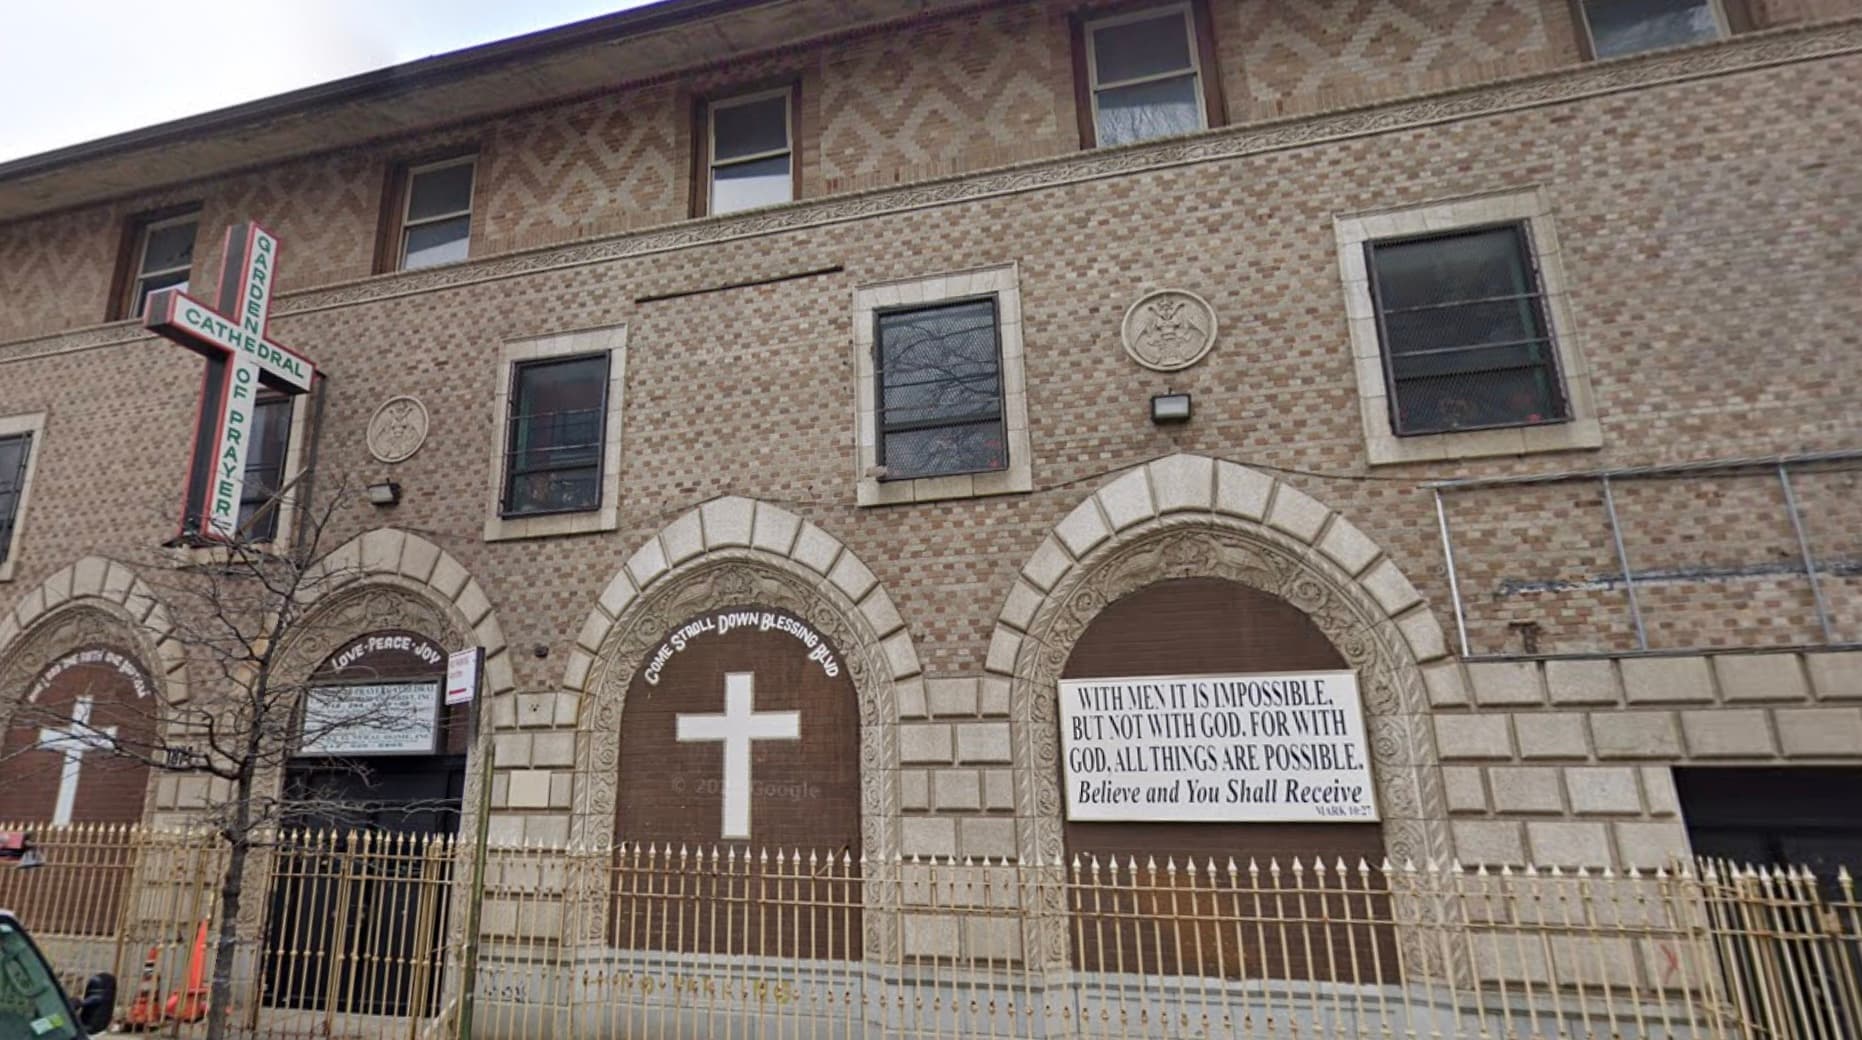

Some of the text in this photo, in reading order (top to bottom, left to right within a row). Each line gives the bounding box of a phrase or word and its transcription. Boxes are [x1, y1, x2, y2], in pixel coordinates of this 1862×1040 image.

[245, 235, 272, 335] GARDEN
[184, 307, 305, 379] CATHEDRAL
[215, 367, 250, 516] OF PRAYER
[644, 612, 840, 685] COME STROLL DOWN BLESSING BLVD
[1078, 686, 1123, 711] WITH
[1127, 684, 1166, 711] MEN
[1170, 684, 1187, 709] IT
[1192, 682, 1210, 709] IS
[1072, 715, 1104, 740] BUT
[1108, 714, 1144, 740] NOT
[1147, 712, 1196, 739] WITH
[1249, 710, 1290, 737] FOR
[1292, 709, 1348, 737] WITH
[1114, 745, 1149, 773] ALL
[1149, 744, 1218, 772] THINGS
[1222, 743, 1260, 772] ARE
[1263, 742, 1365, 772] POSSIBLE.
[1078, 777, 1363, 804] Believe and You Shall Receive
